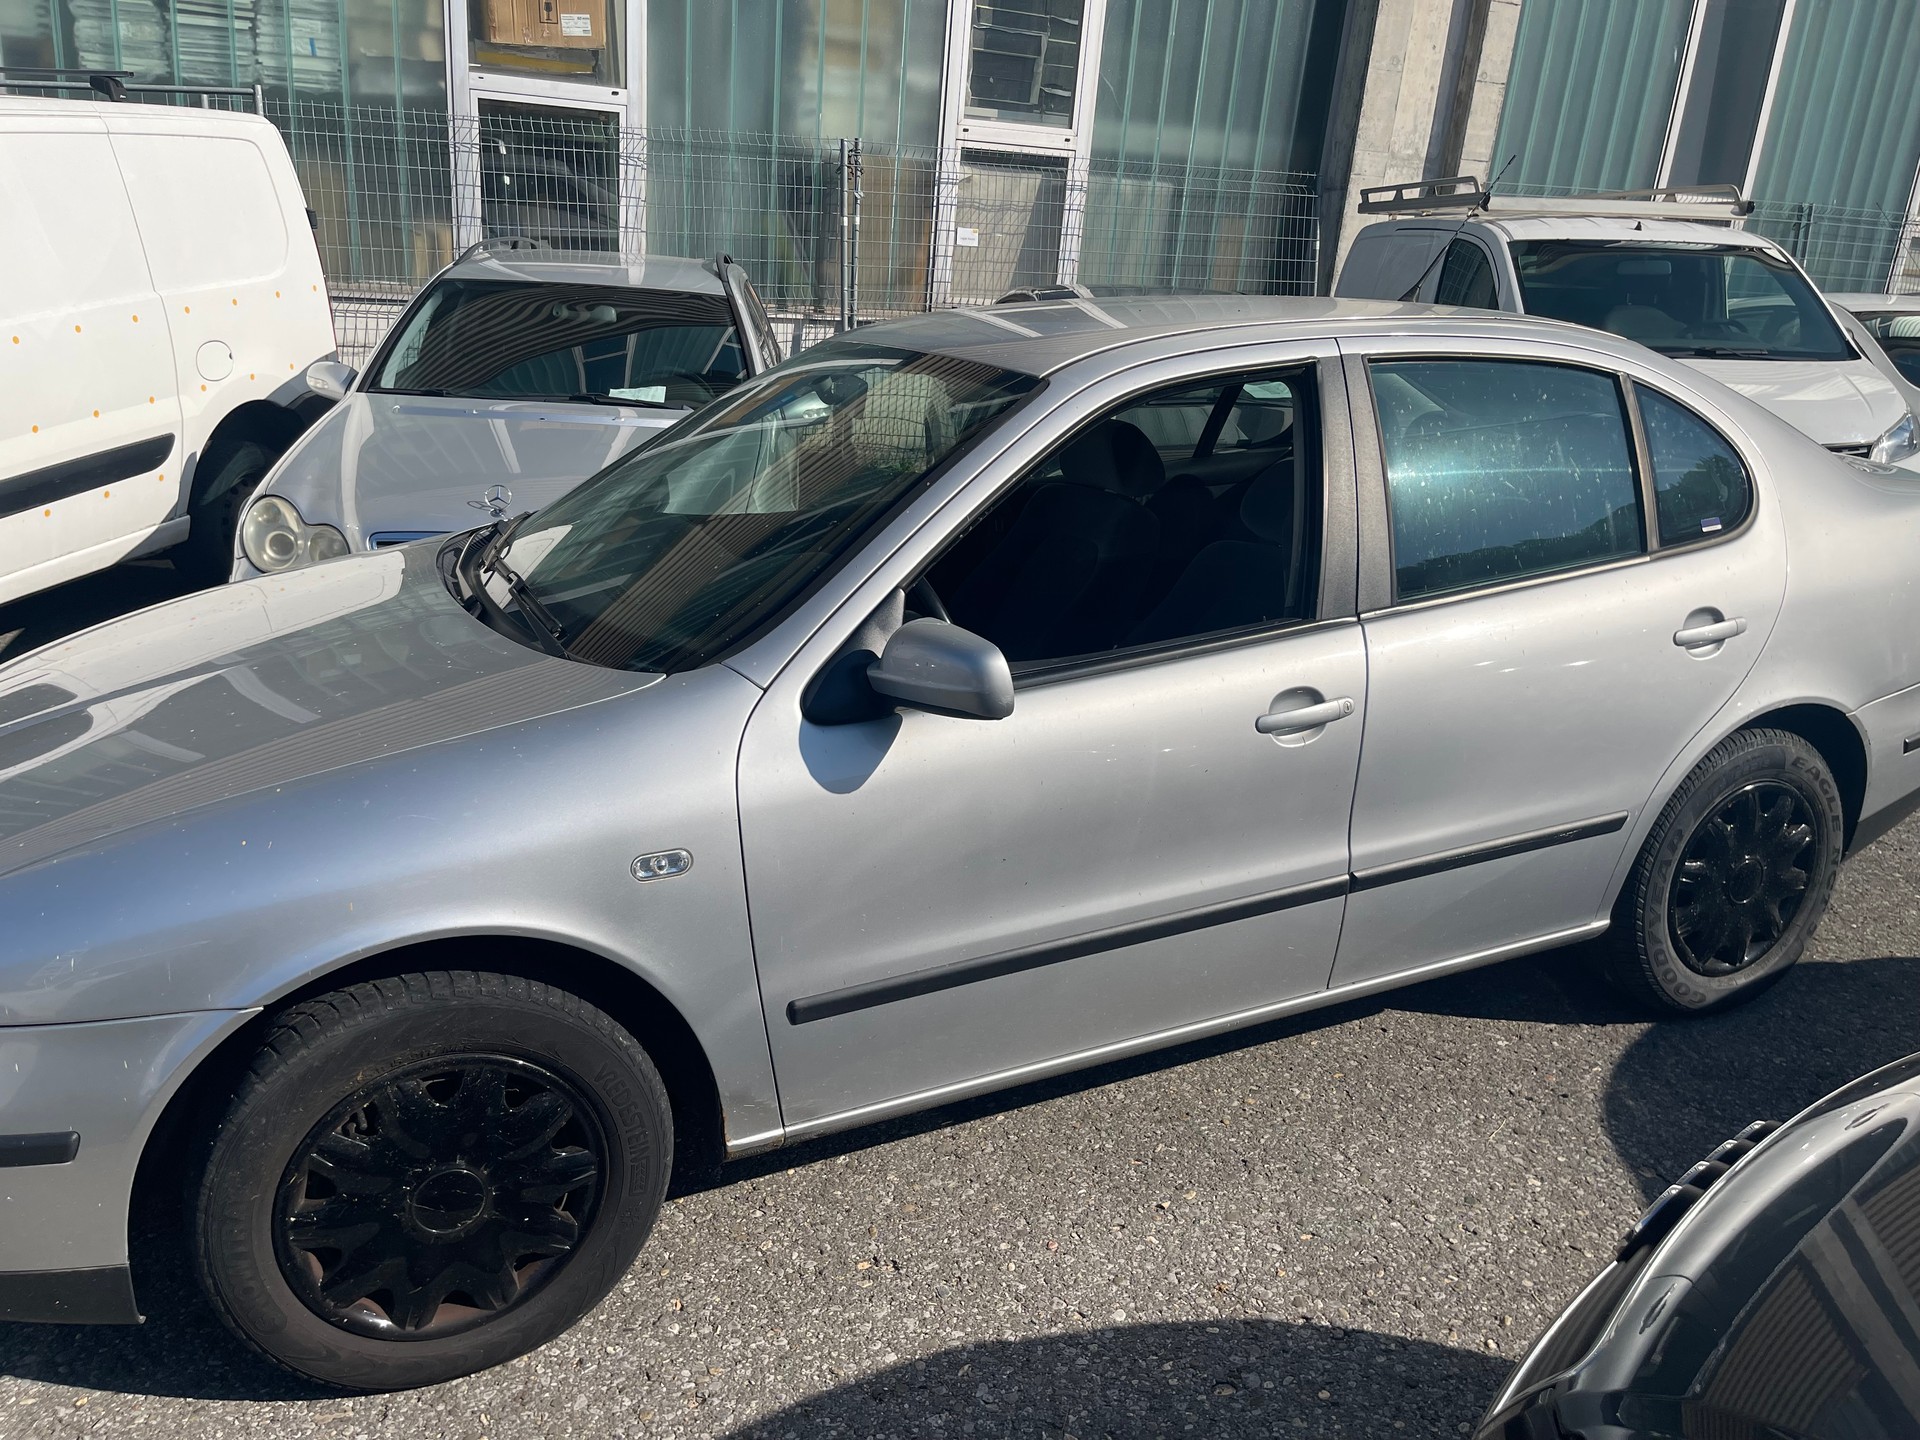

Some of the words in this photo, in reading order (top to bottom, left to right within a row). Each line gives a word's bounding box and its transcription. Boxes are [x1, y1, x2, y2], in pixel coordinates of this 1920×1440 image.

[1791, 756, 1841, 833] EAGLE
[1648, 829, 1706, 1003] GOODYEAR
[594, 1062, 650, 1163] VREDESTEIN
